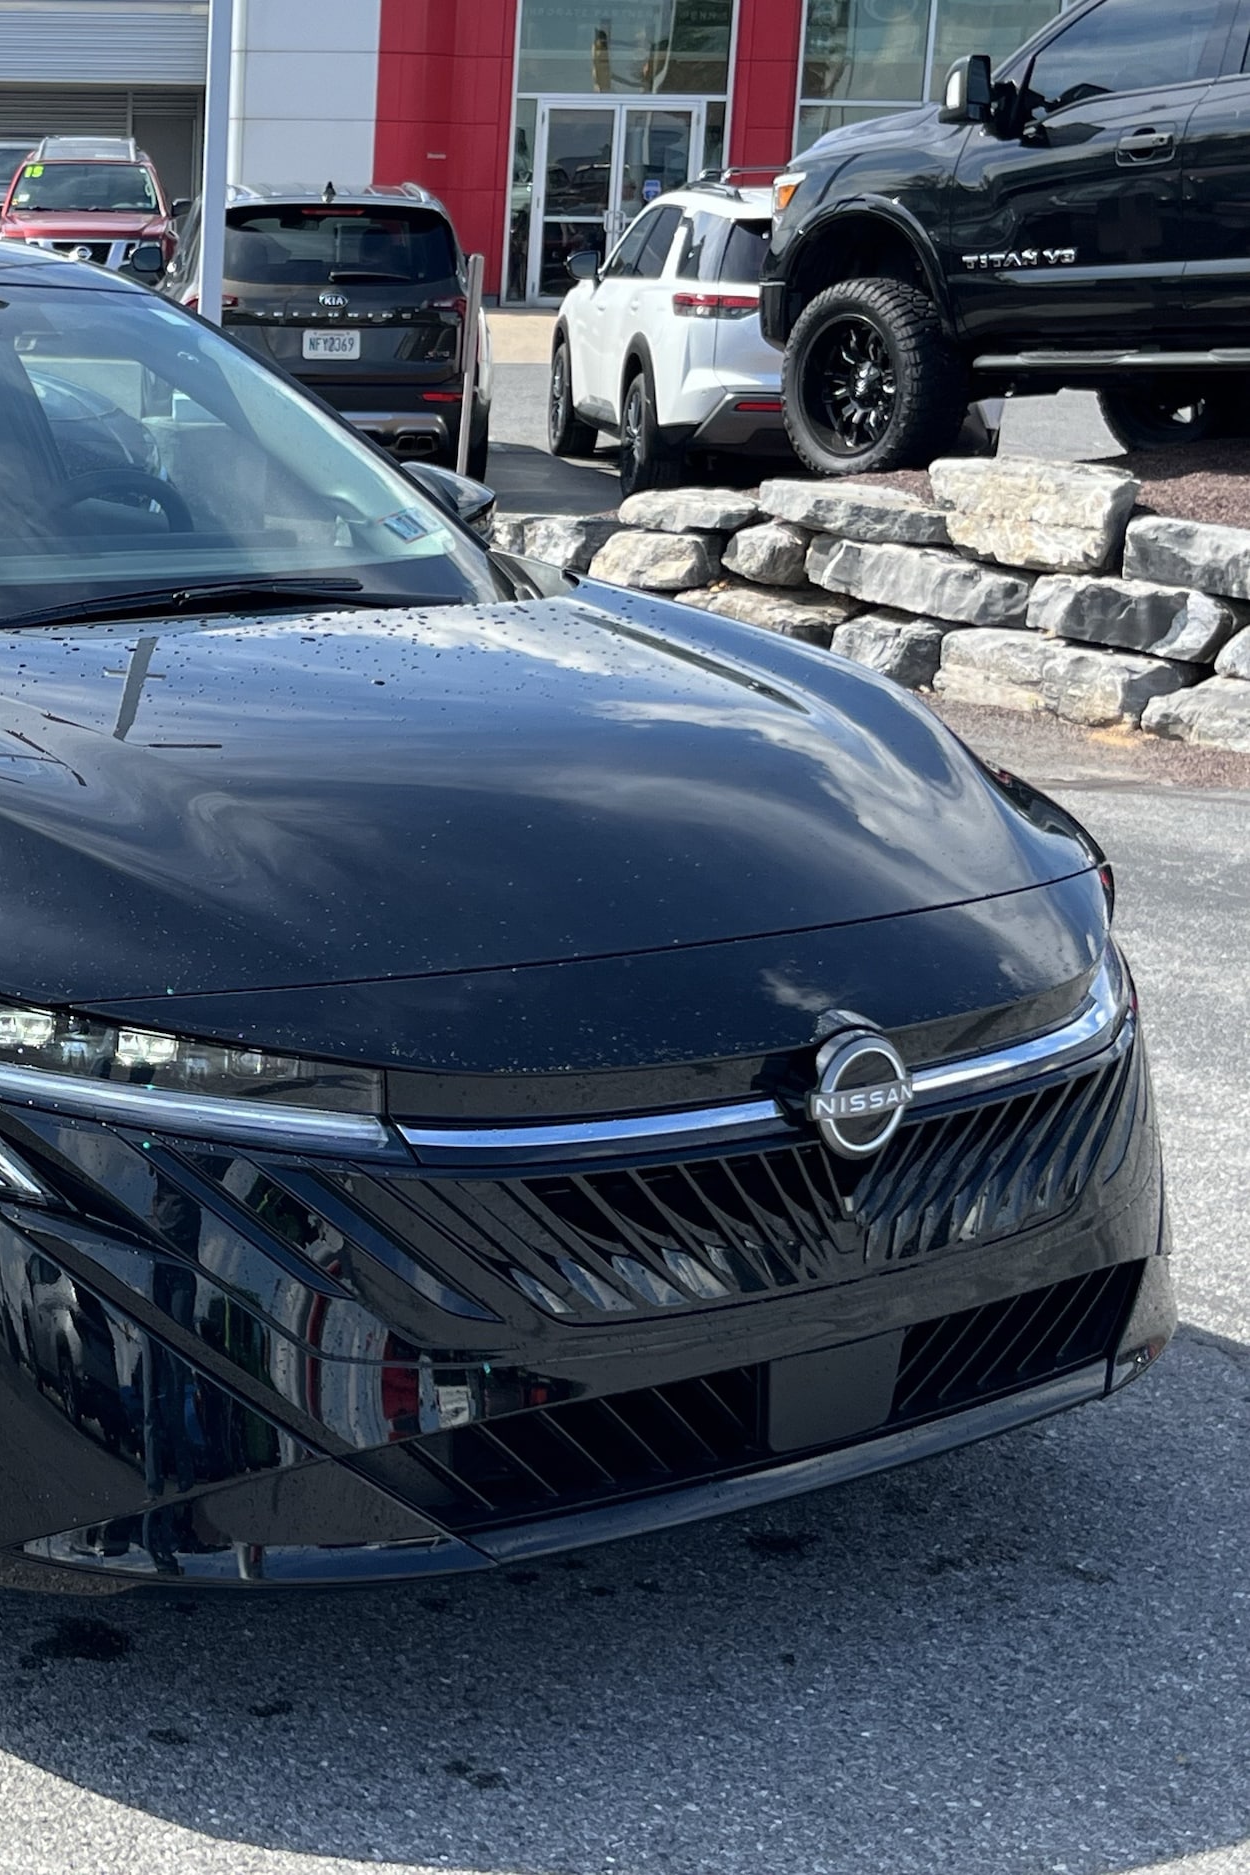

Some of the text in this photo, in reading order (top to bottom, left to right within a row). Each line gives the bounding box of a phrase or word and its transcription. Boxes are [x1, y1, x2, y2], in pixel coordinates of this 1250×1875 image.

[962, 247, 1078, 269] TITAN V8
[323, 296, 344, 306] KIA
[815, 1084, 913, 1115] NISSAN
